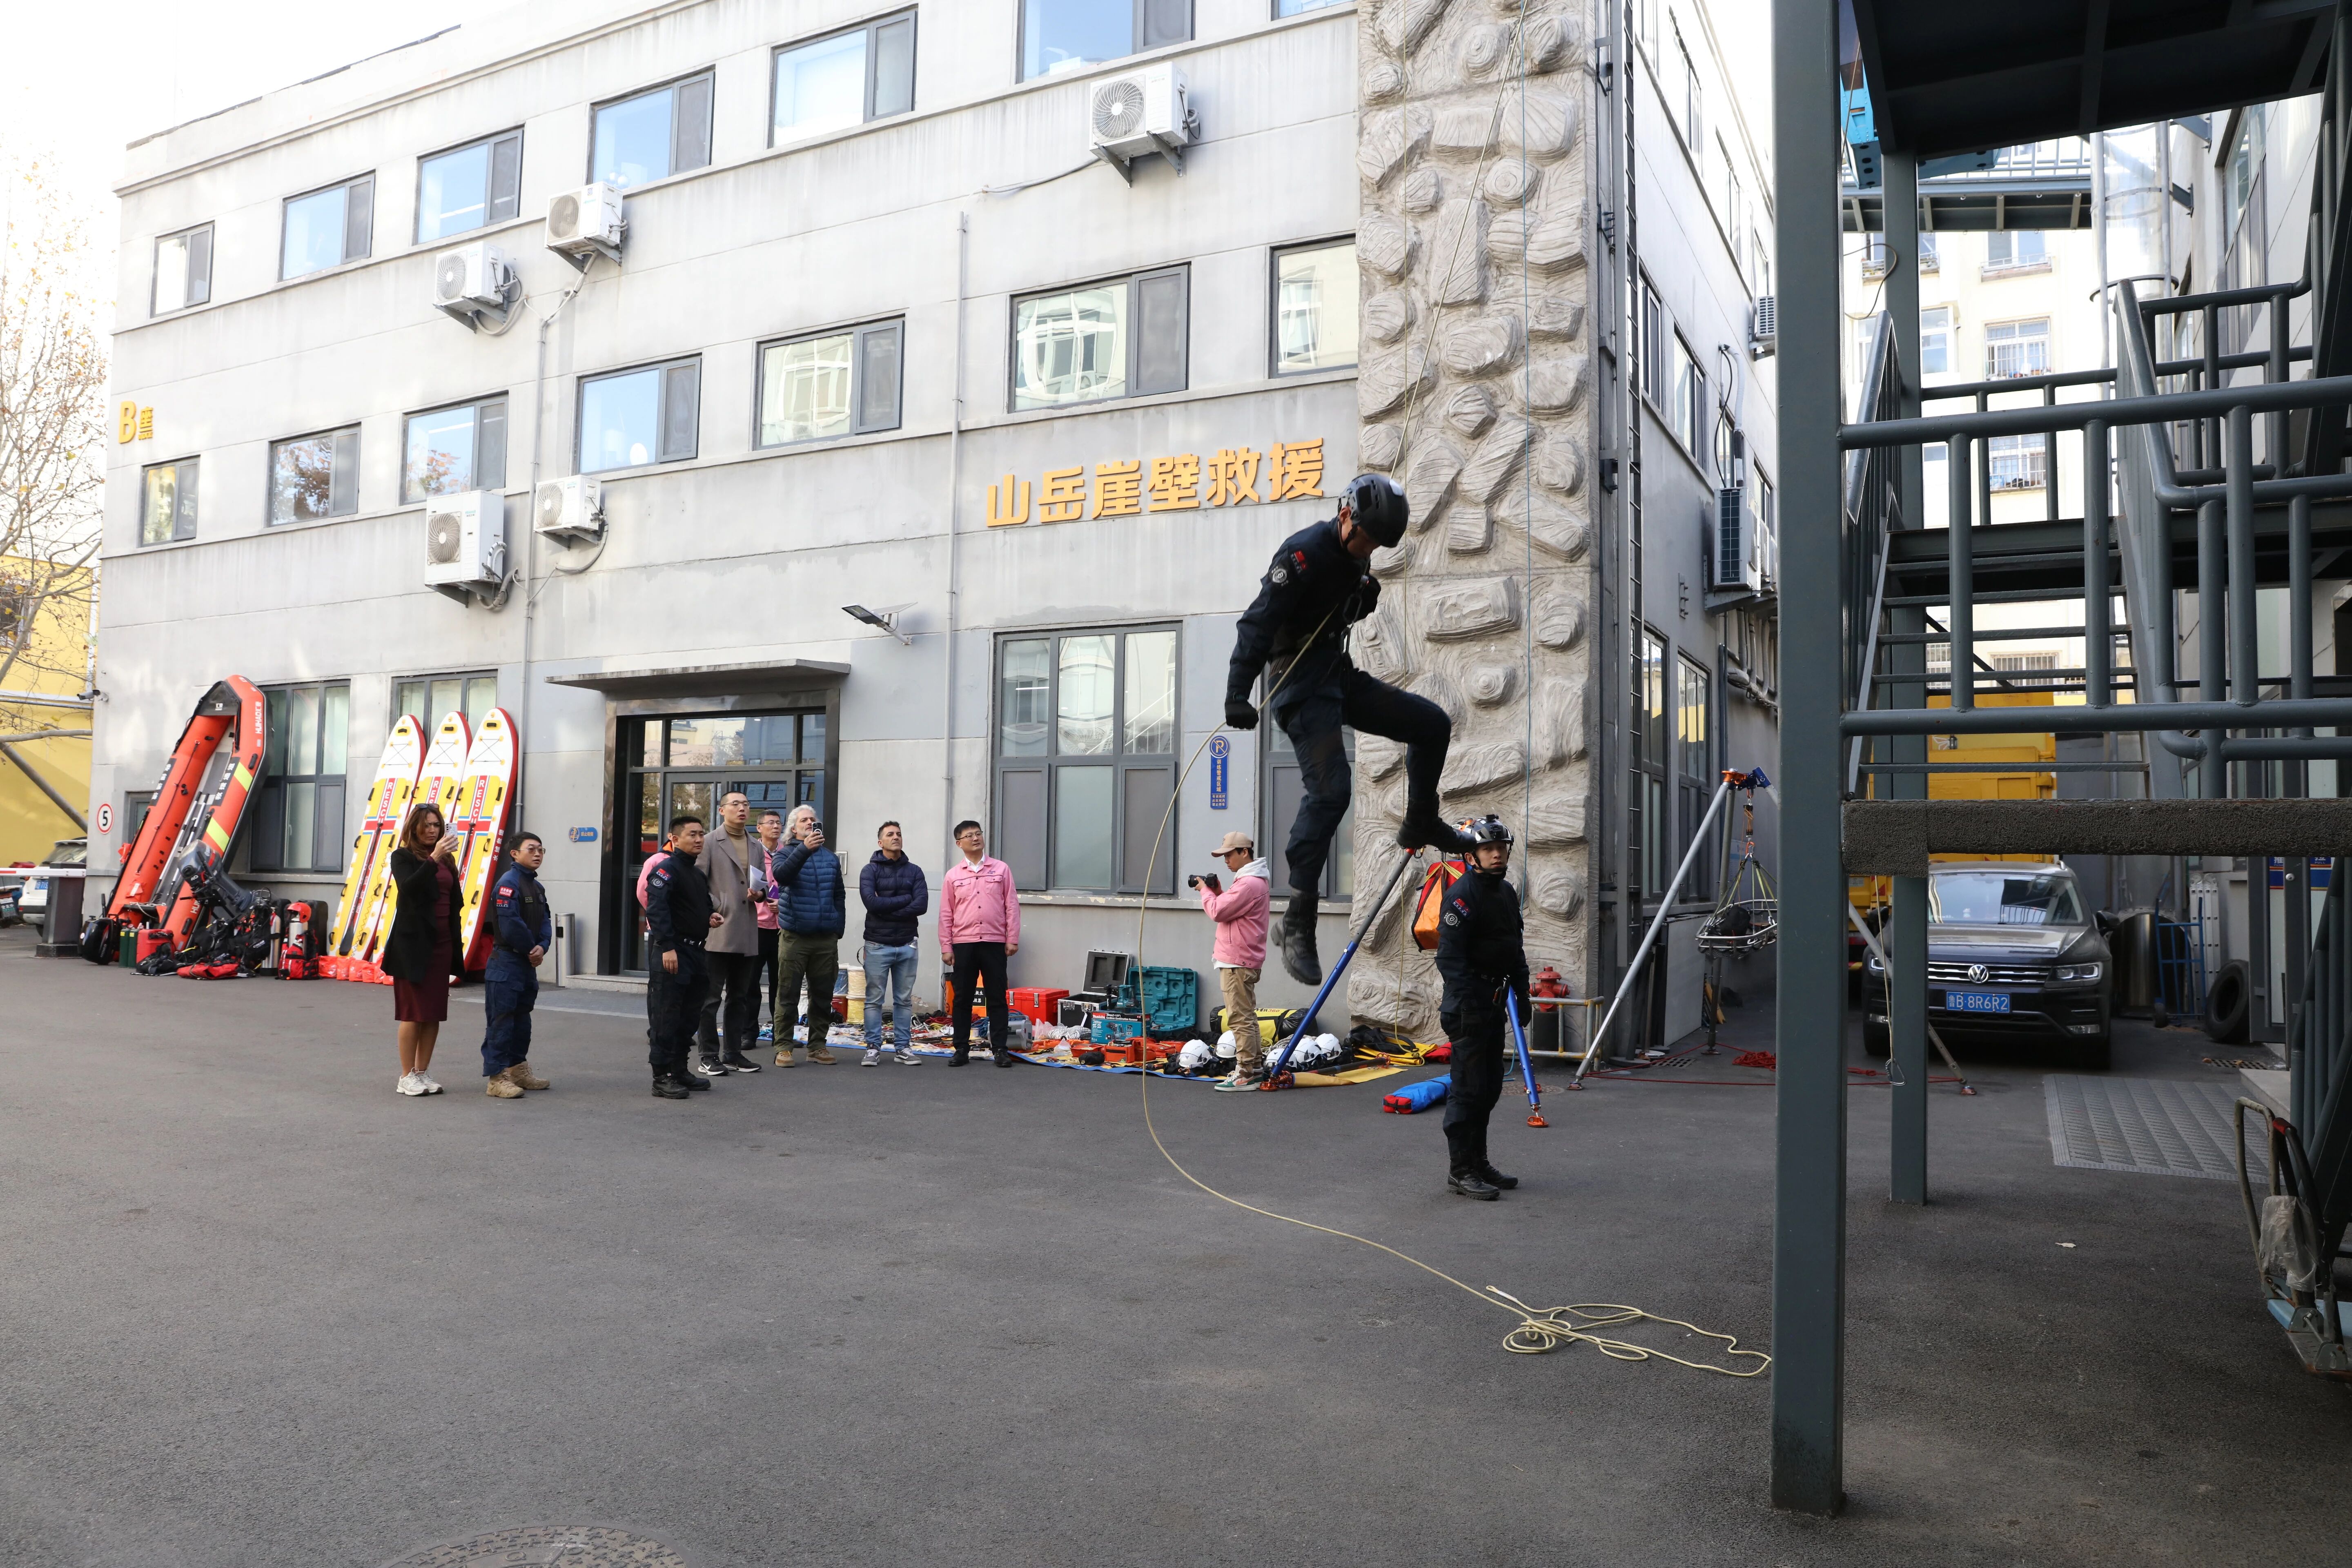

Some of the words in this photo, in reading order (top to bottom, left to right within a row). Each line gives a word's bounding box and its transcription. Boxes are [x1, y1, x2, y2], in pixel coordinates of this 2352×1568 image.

[986, 437, 1324, 527] 山岳崖壁救援
[429, 780, 439, 804] RES
[102, 811, 108, 826] 5
